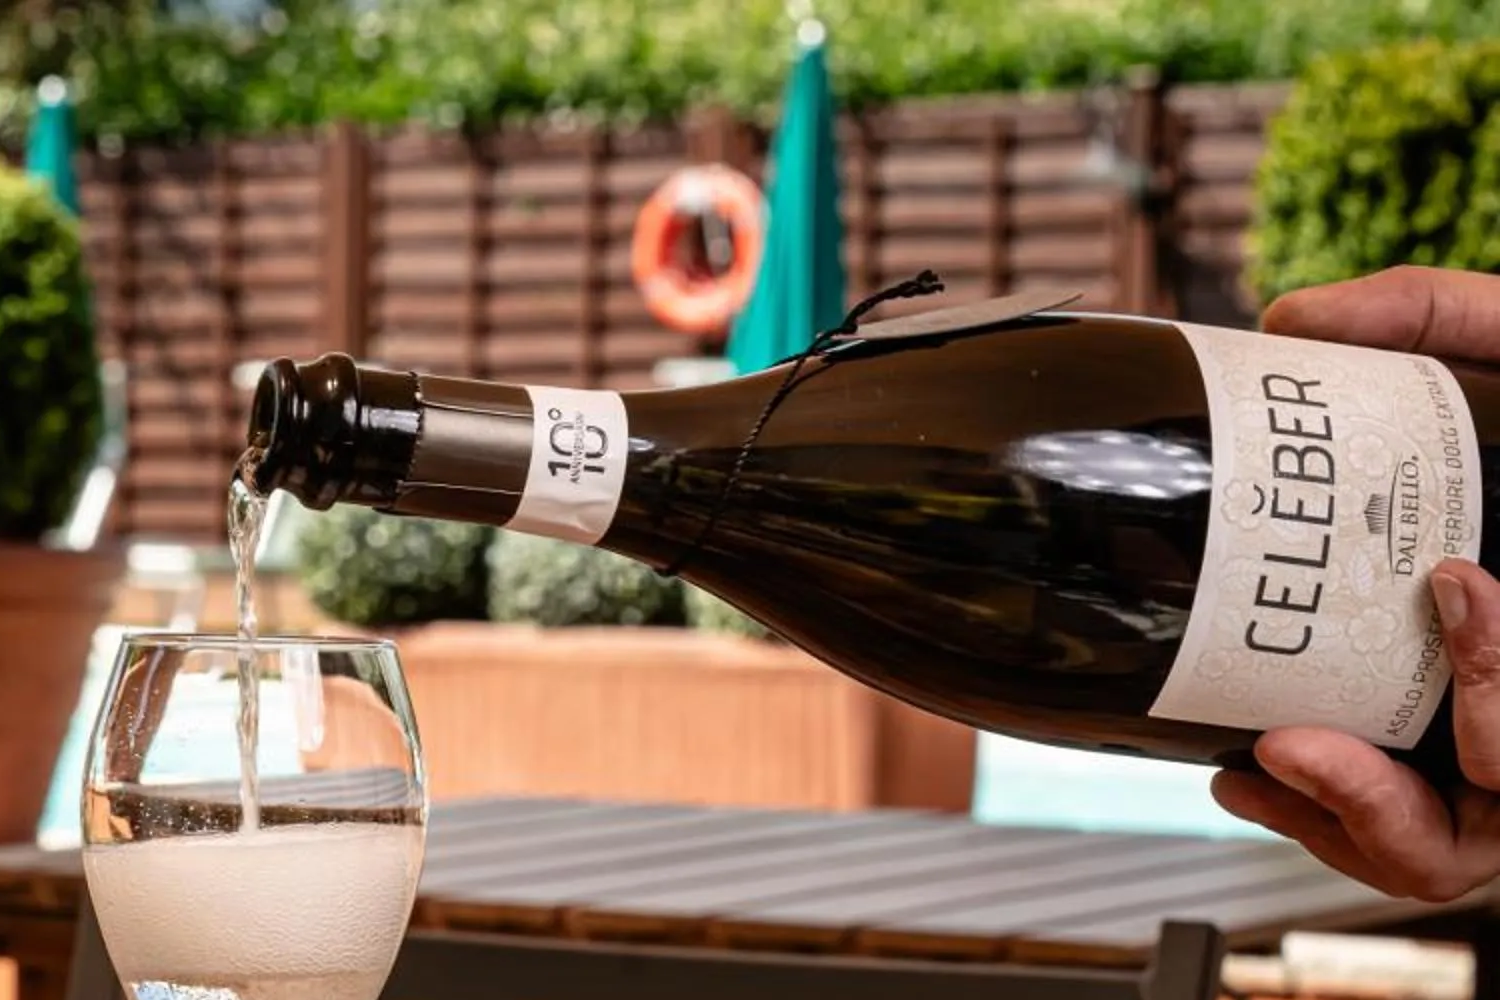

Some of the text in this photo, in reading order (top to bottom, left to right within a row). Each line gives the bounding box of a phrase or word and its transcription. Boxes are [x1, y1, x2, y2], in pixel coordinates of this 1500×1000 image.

[1441, 427, 1464, 469] DOCG
[1443, 475, 1465, 559] PERIORE
[1395, 533, 1417, 576] DAL
[1412, 602, 1443, 683] PROSEC
[1385, 688, 1422, 737] ASOLO
